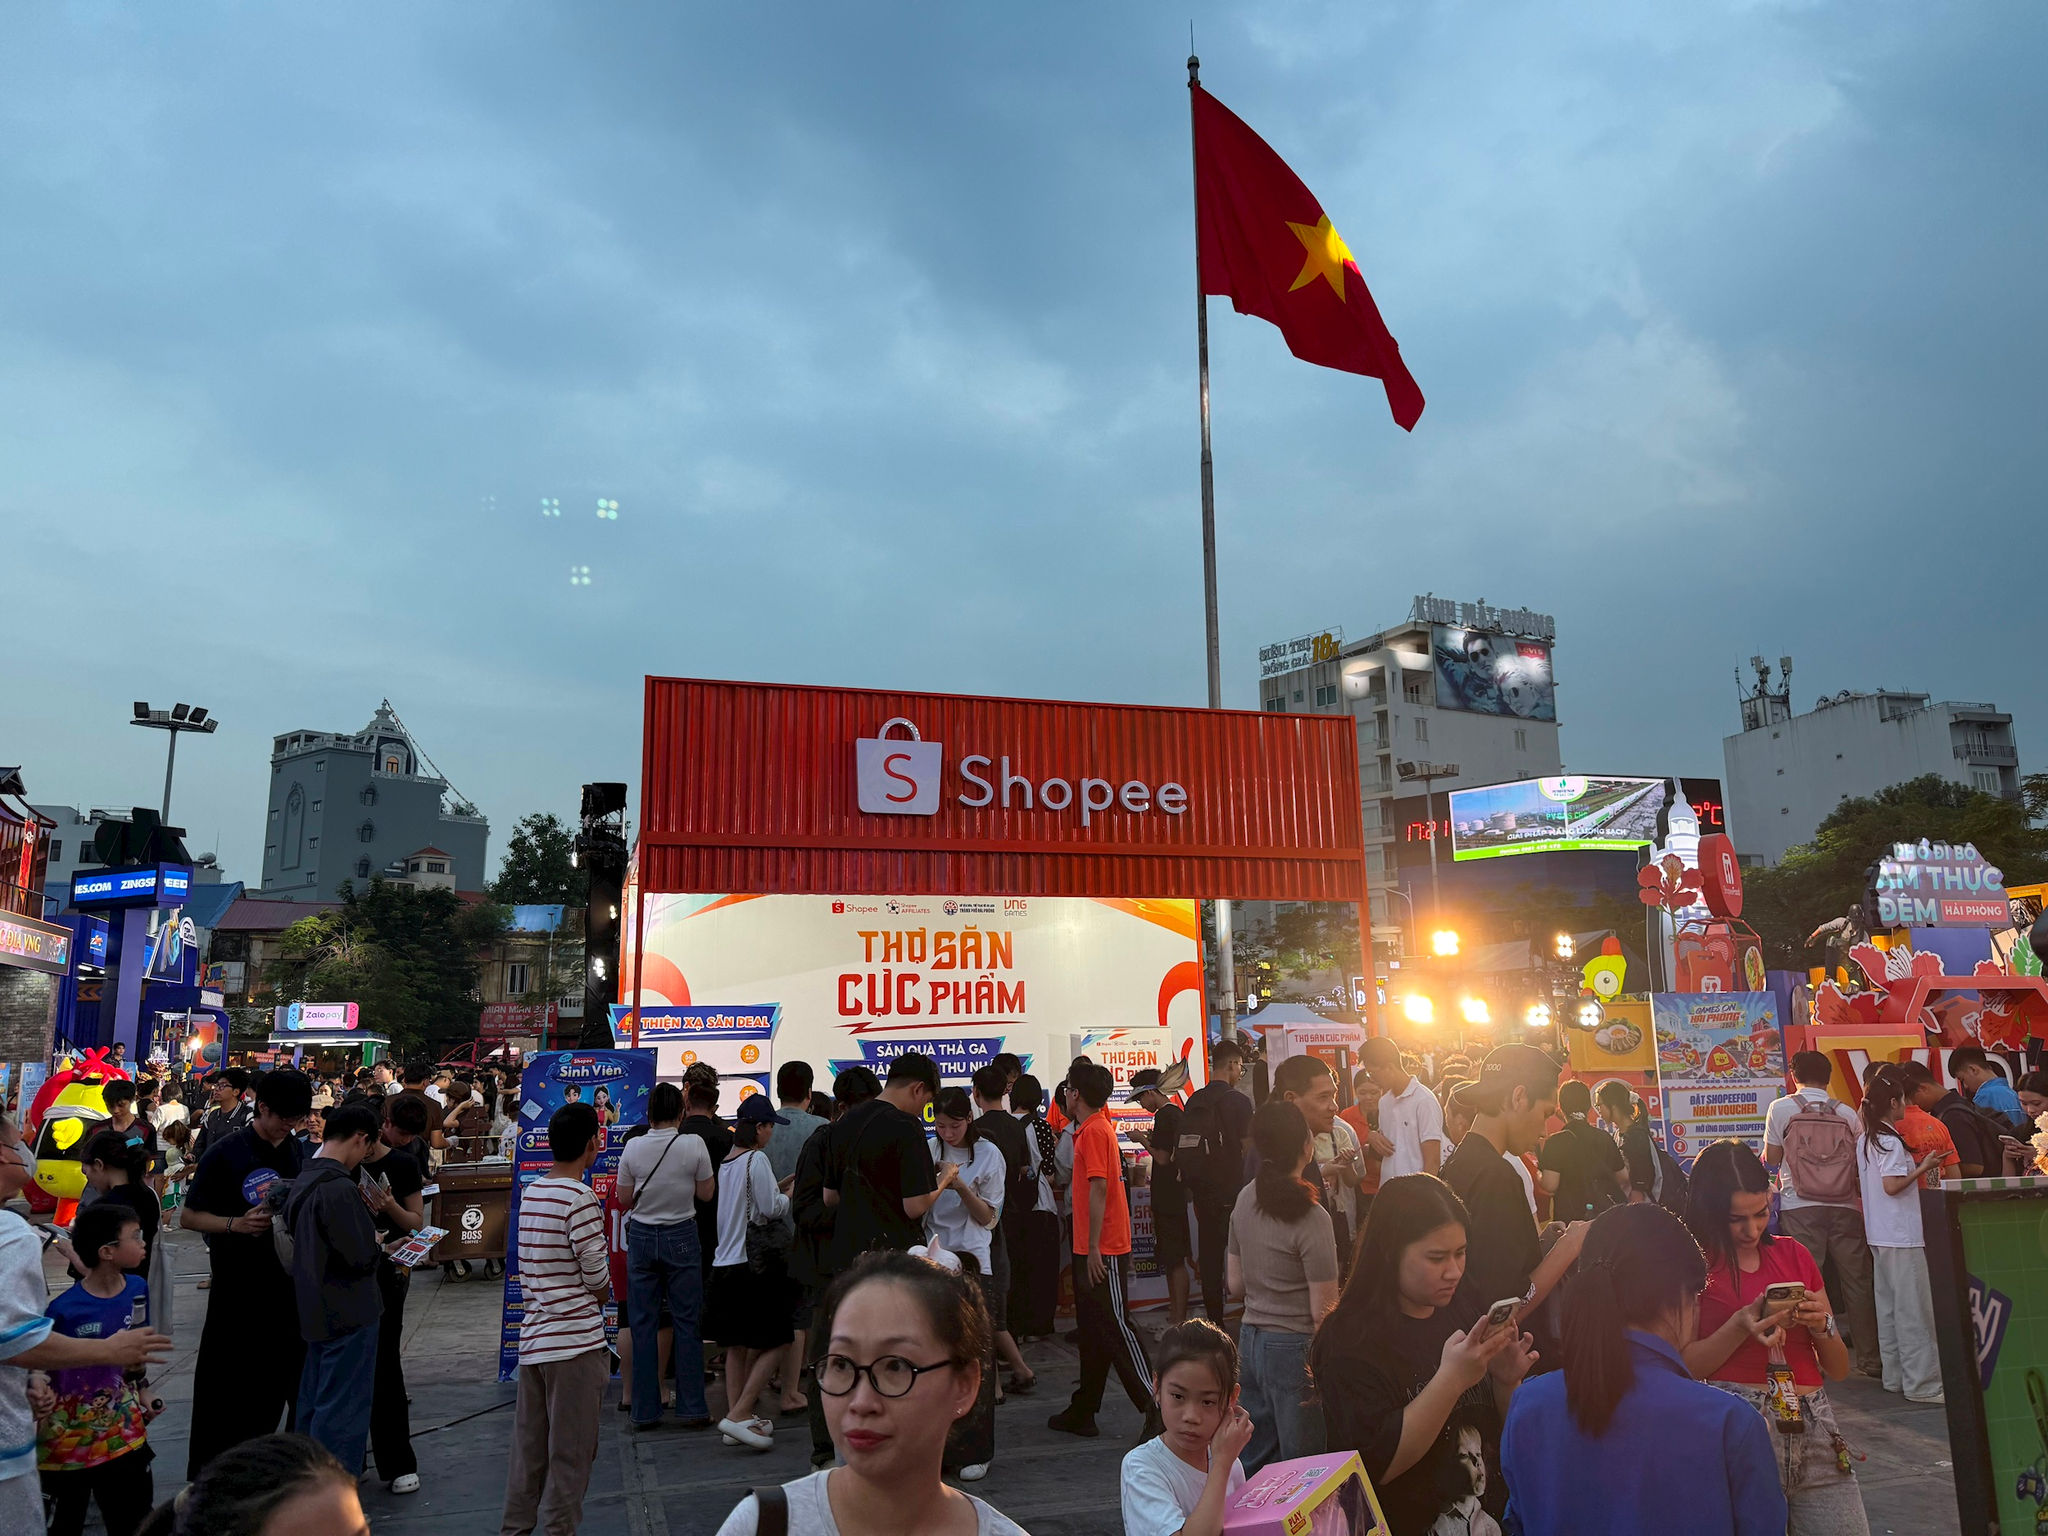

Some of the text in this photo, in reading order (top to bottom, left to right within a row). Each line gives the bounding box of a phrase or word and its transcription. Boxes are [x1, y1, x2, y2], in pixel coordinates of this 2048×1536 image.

[958, 754, 1188, 827] Shopee
[1893, 838, 1976, 864] PHỐ ĐI BỘ
[1926, 865, 2003, 896] THỰC
[846, 904, 878, 914] Shopee
[1878, 892, 1938, 922] ĐÊM
[1945, 902, 2002, 915] HẢI PHÒNG
[24, 934, 41, 953] VNG
[857, 924, 1012, 969] THỢ SĂN
[838, 969, 1025, 1017] CỰC PHẨM
[1696, 1006, 1720, 1014] GAMES
[642, 1014, 770, 1031] THIỆN XẠ SĂN DEAL
[877, 1040, 988, 1057] SĂN QUÀ THẢ GA
[560, 1065, 622, 1077] Sinh Viên
[940, 1062, 967, 1073] THU
[1706, 1093, 1757, 1105] SHOPEEFOOD
[1693, 1104, 1757, 1118] NHẬN VOUCHER
[526, 1135, 535, 1147] 3
[462, 1230, 482, 1240] BOSS
[1288, 1510, 1303, 1527] PLAY
